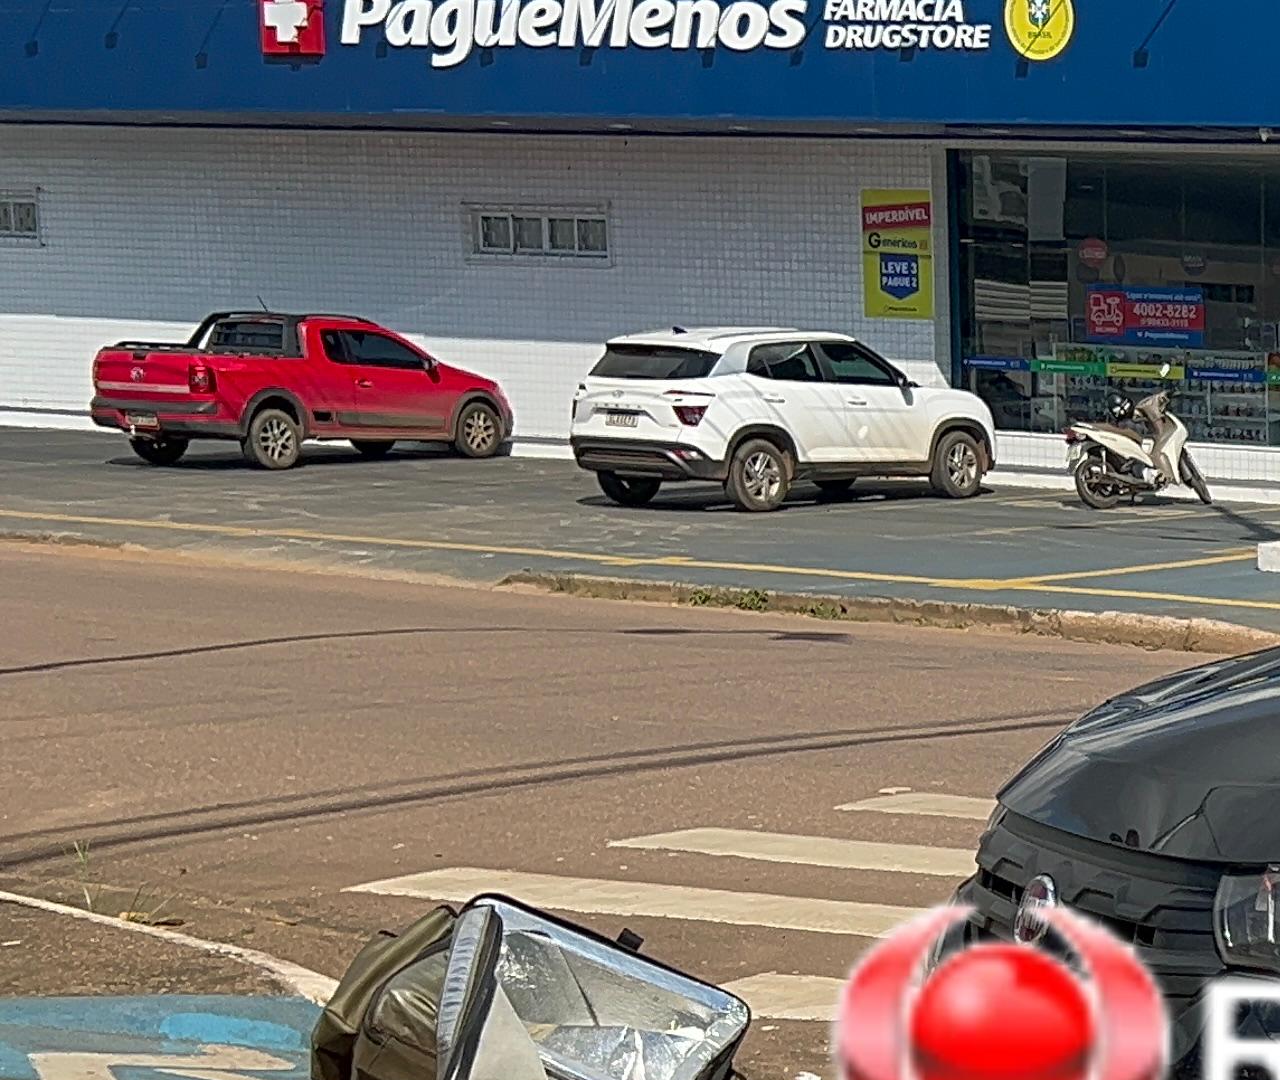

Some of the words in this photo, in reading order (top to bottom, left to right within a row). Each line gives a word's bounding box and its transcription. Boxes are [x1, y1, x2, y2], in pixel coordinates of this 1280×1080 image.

[341, 0, 808, 67] PagueMenos
[825, 24, 992, 49] DRUGSTORE
[865, 206, 928, 225] IMPERDÍVEL
[881, 261, 908, 275] LEVE
[910, 261, 918, 275] 3
[1133, 303, 1197, 319] 4002-8282
